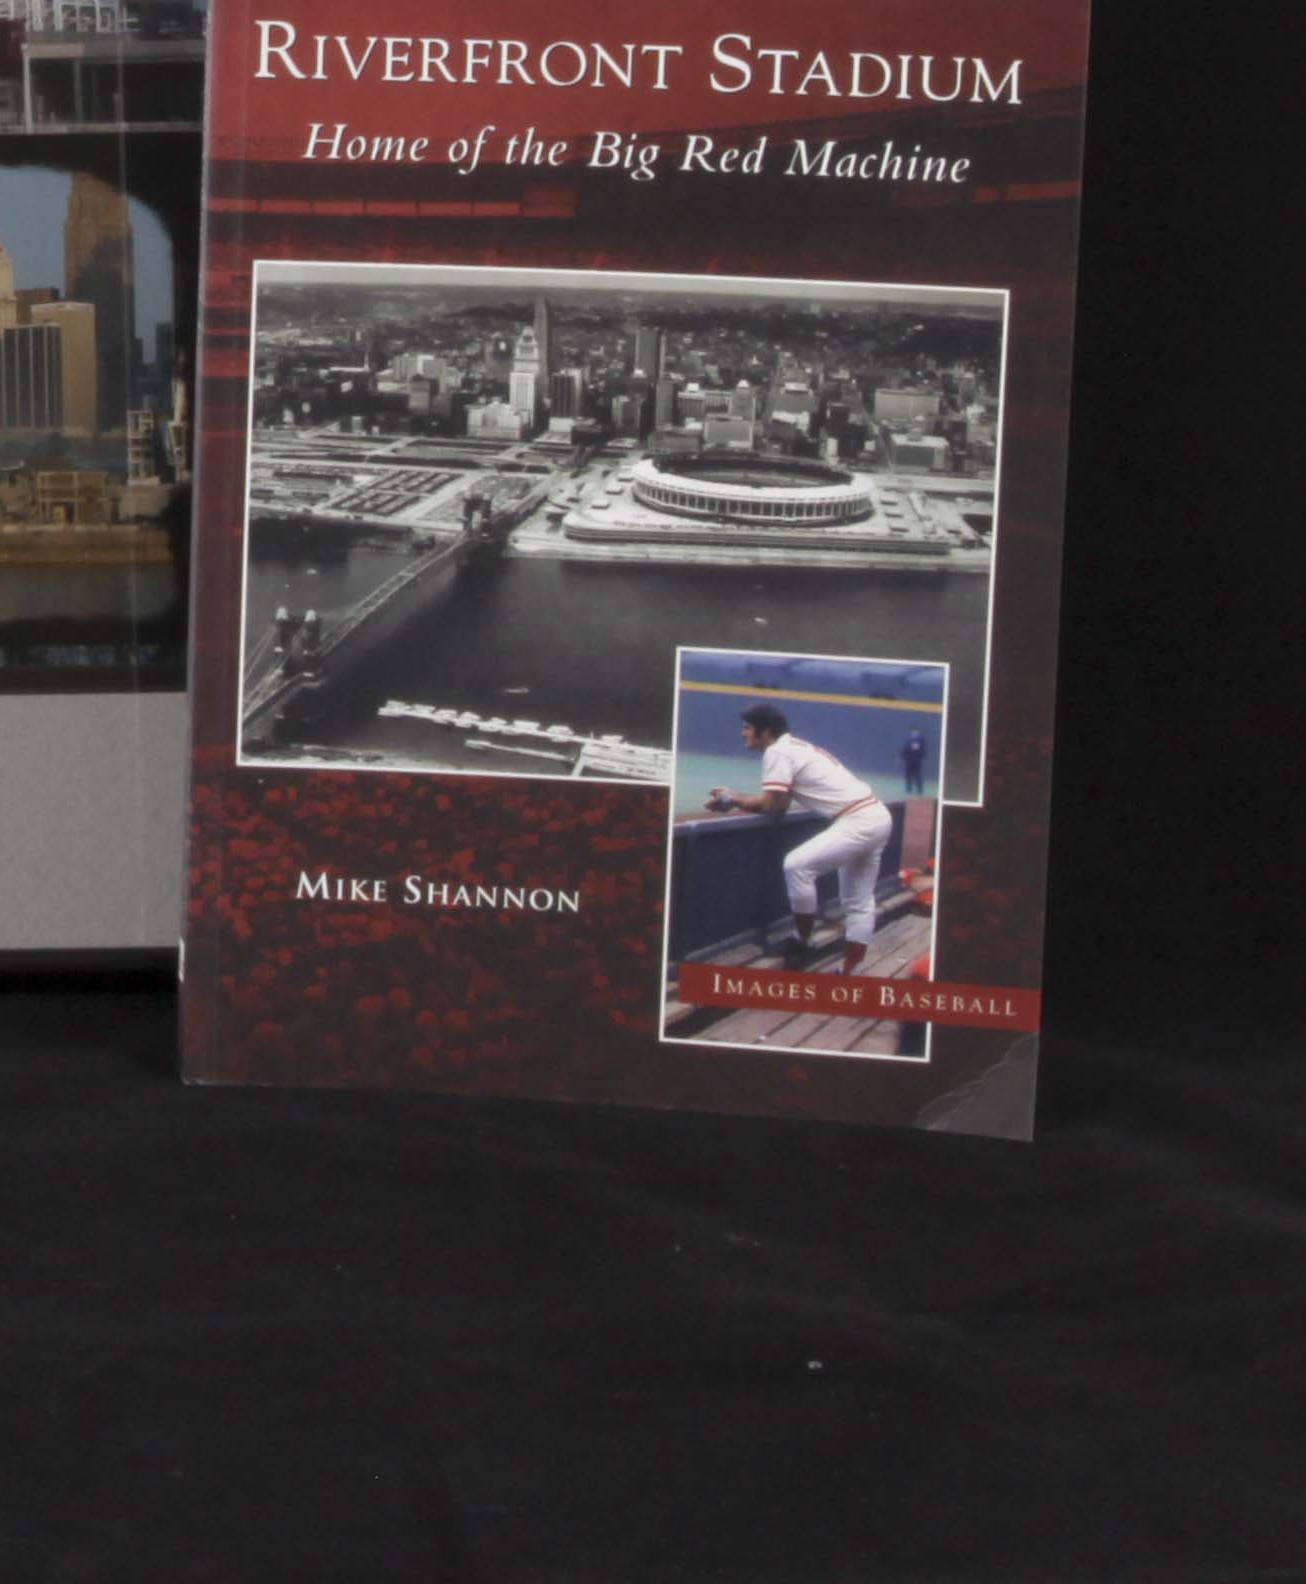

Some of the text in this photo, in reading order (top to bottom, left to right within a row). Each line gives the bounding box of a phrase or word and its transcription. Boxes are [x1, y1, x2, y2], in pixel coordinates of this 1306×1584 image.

[253, 19, 1025, 106] RIVERFRONT STADIUM
[300, 121, 972, 185] Home of the Big Red Machine
[295, 871, 581, 915] MIKE SHANNON
[712, 972, 1018, 1018] IMAGES OF BASEBALL
